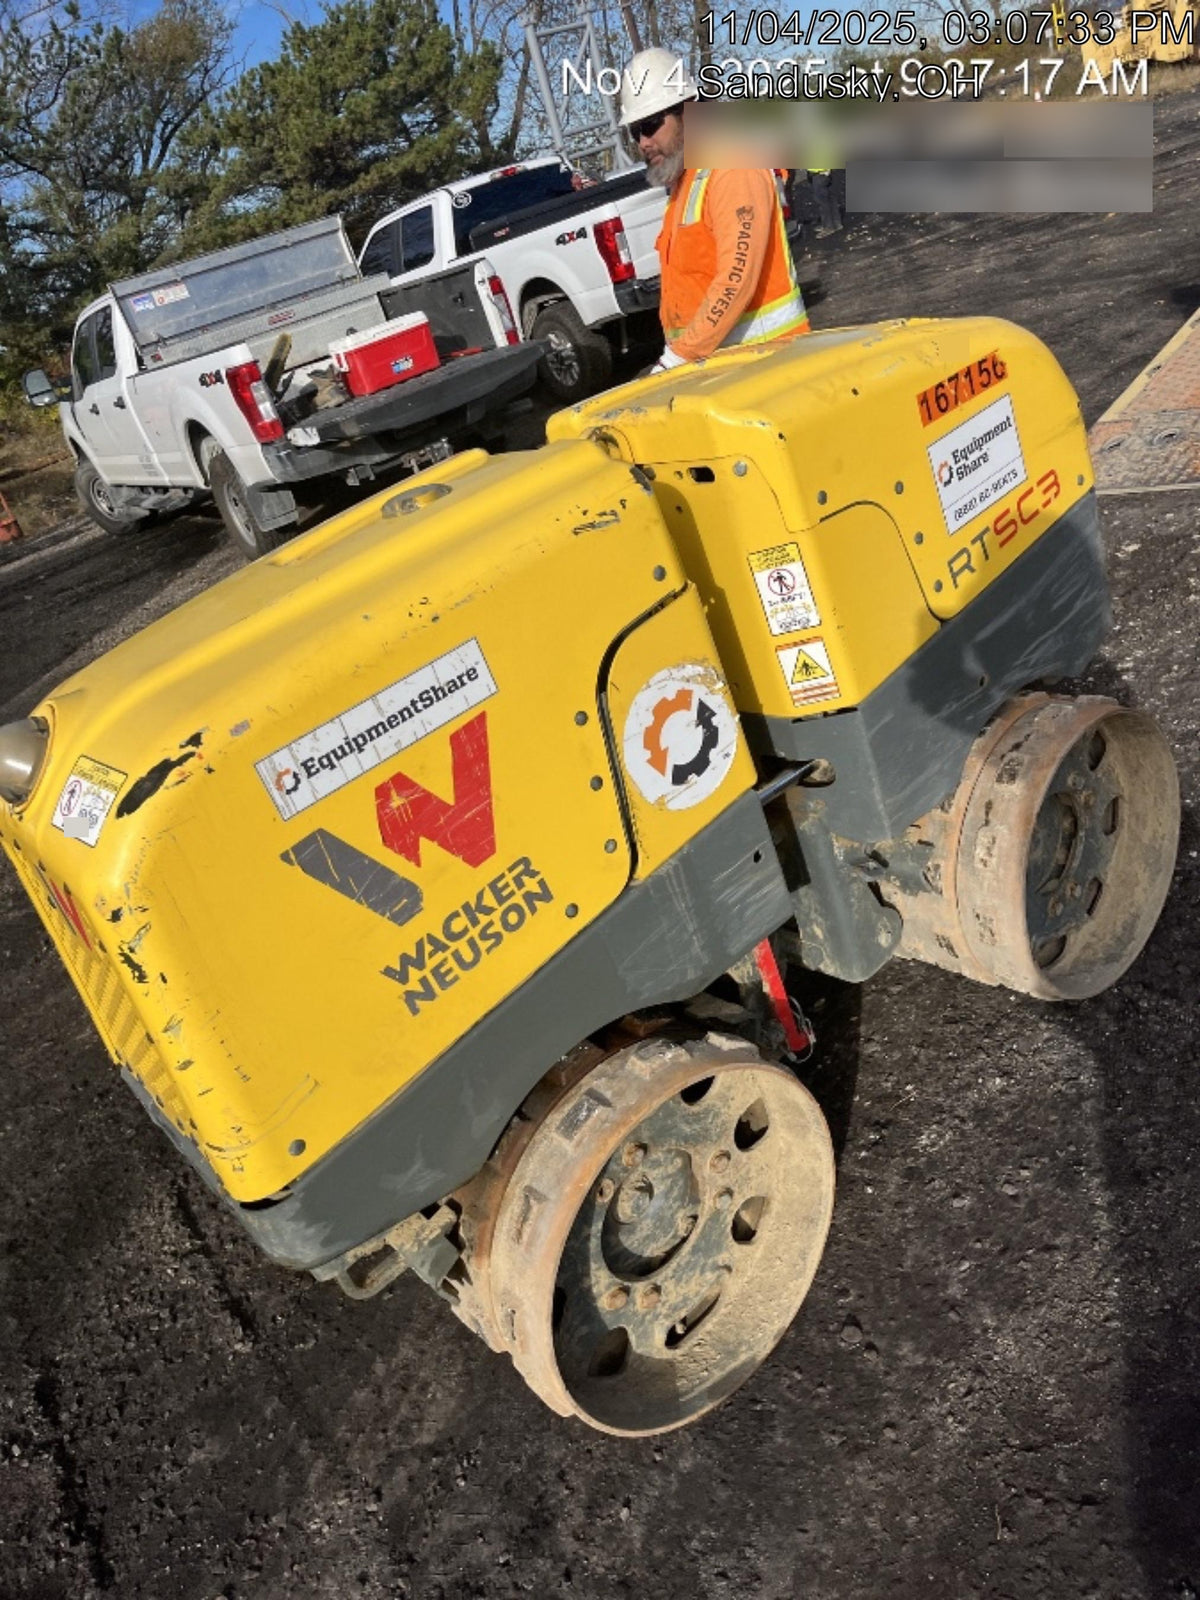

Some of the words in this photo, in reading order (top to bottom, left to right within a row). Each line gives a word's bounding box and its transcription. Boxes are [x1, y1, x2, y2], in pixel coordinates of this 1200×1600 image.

[728, 221, 752, 284] PACIFIC
[706, 287, 737, 328] WEST
[919, 353, 1007, 422] 167156
[951, 415, 1013, 465] Equipment
[955, 451, 990, 481] Share
[300, 663, 480, 779] EquipmentShare
[379, 855, 541, 985] WACKER
[398, 877, 555, 1016] NEUSON
